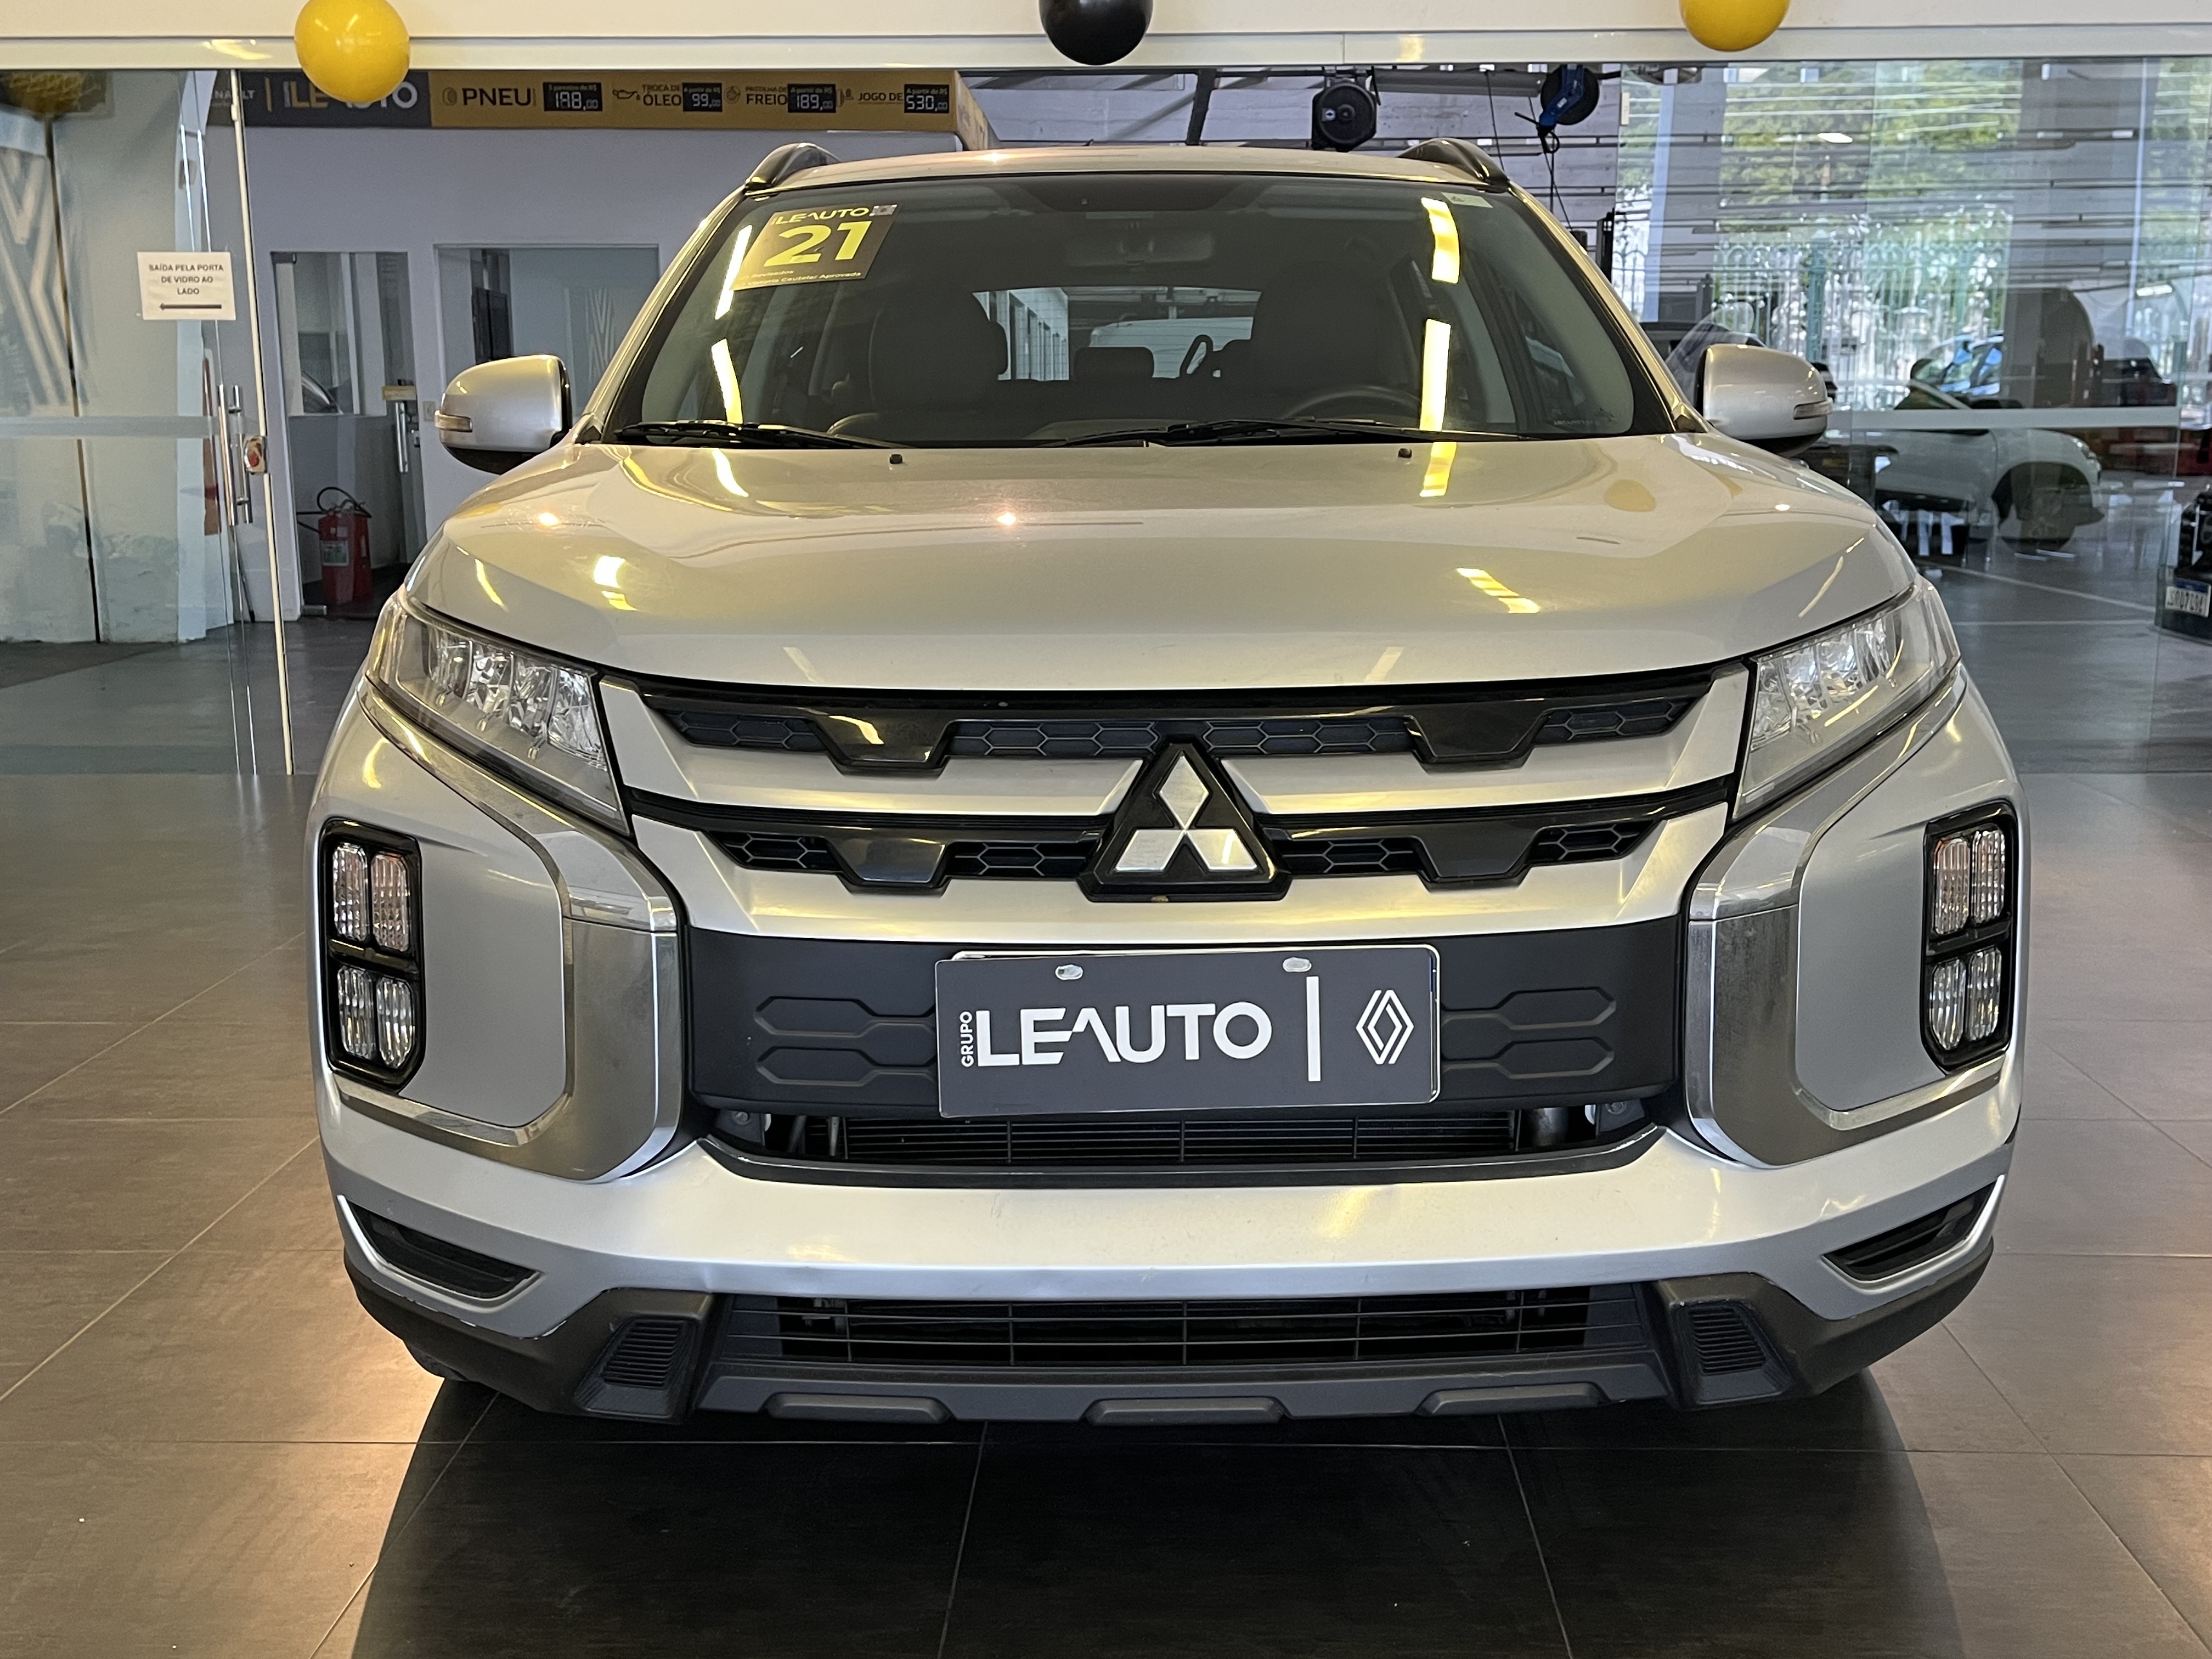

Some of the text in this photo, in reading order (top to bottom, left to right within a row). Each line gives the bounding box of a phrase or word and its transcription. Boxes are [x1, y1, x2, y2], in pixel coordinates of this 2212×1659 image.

[290, 81, 418, 109] LEO
[462, 88, 531, 106] PNEU
[747, 94, 787, 105] FREIO
[858, 92, 903, 101] JOGO DE
[775, 207, 870, 225] LEAUTO
[764, 221, 872, 267] 21
[959, 1011, 974, 1068] GRUPO
[976, 1002, 1272, 1066] LEAUTO
